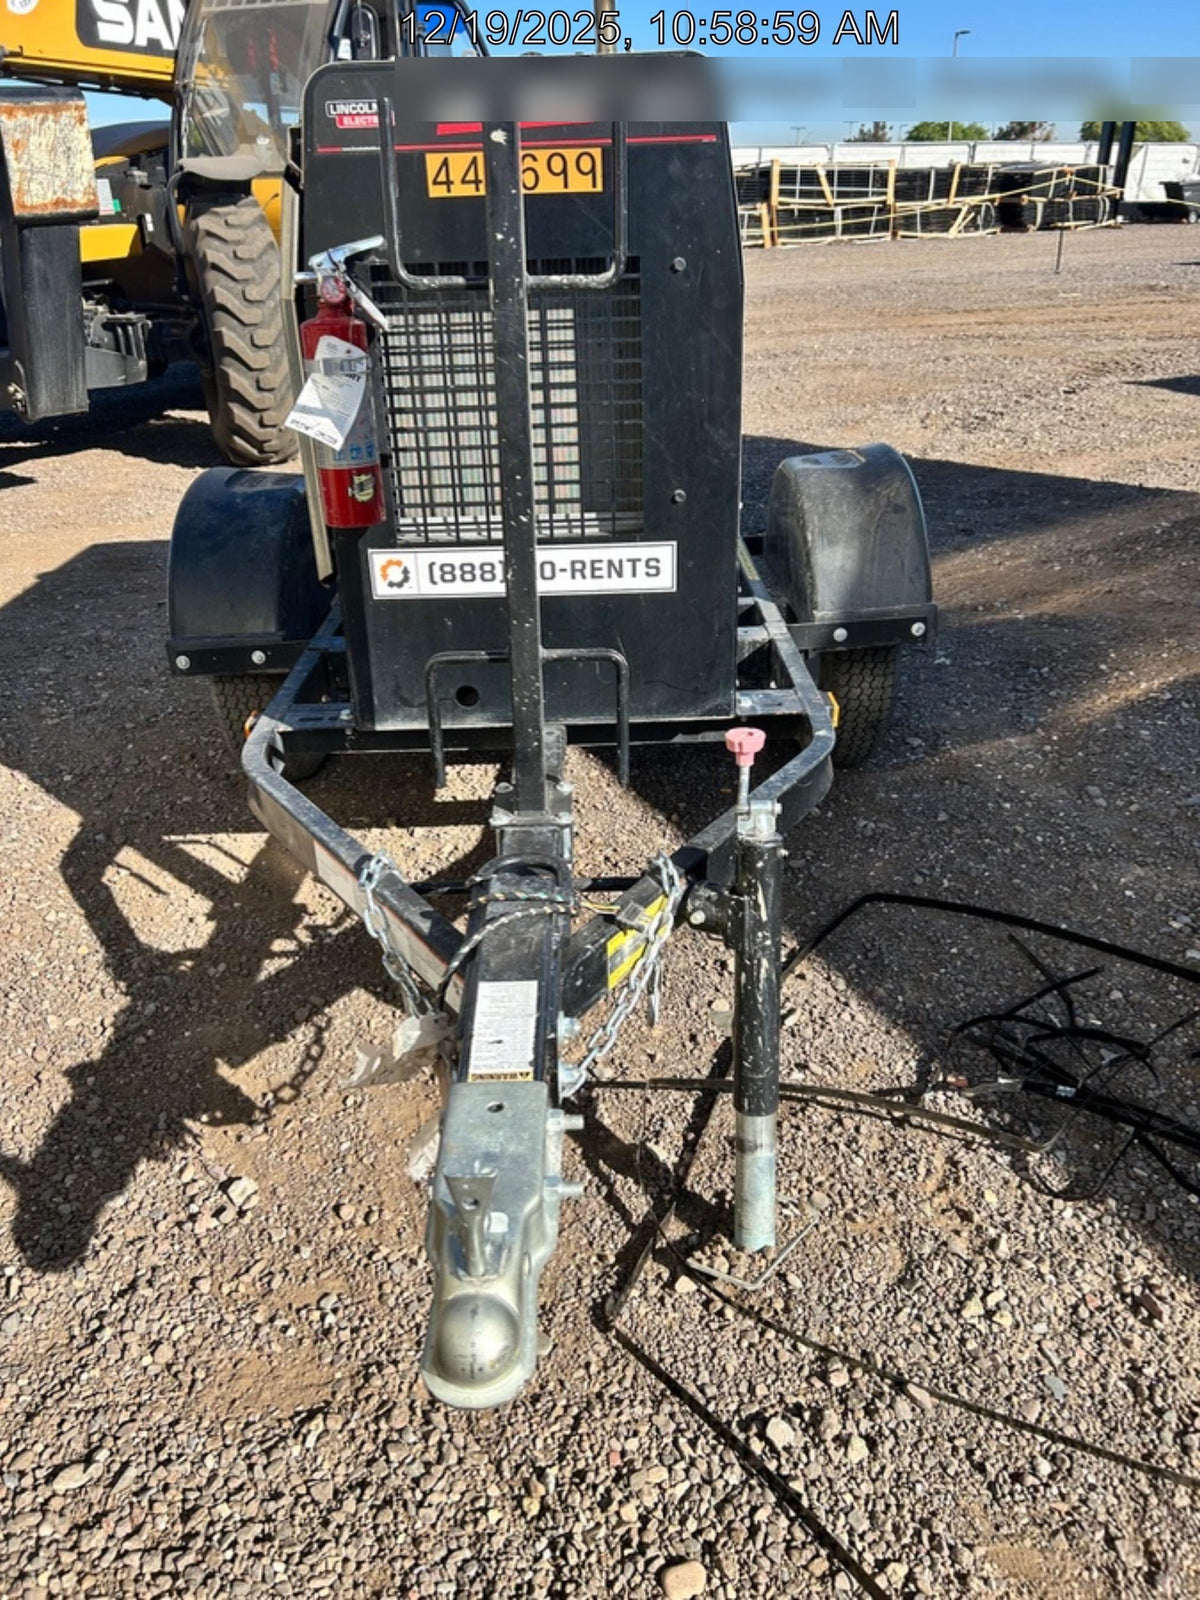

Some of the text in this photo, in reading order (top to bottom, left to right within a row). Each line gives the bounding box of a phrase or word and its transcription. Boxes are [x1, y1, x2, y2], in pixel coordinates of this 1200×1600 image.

[342, 115, 379, 126] ELECTR
[431, 152, 597, 193] 44699
[539, 557, 661, 581] O-RENTS
